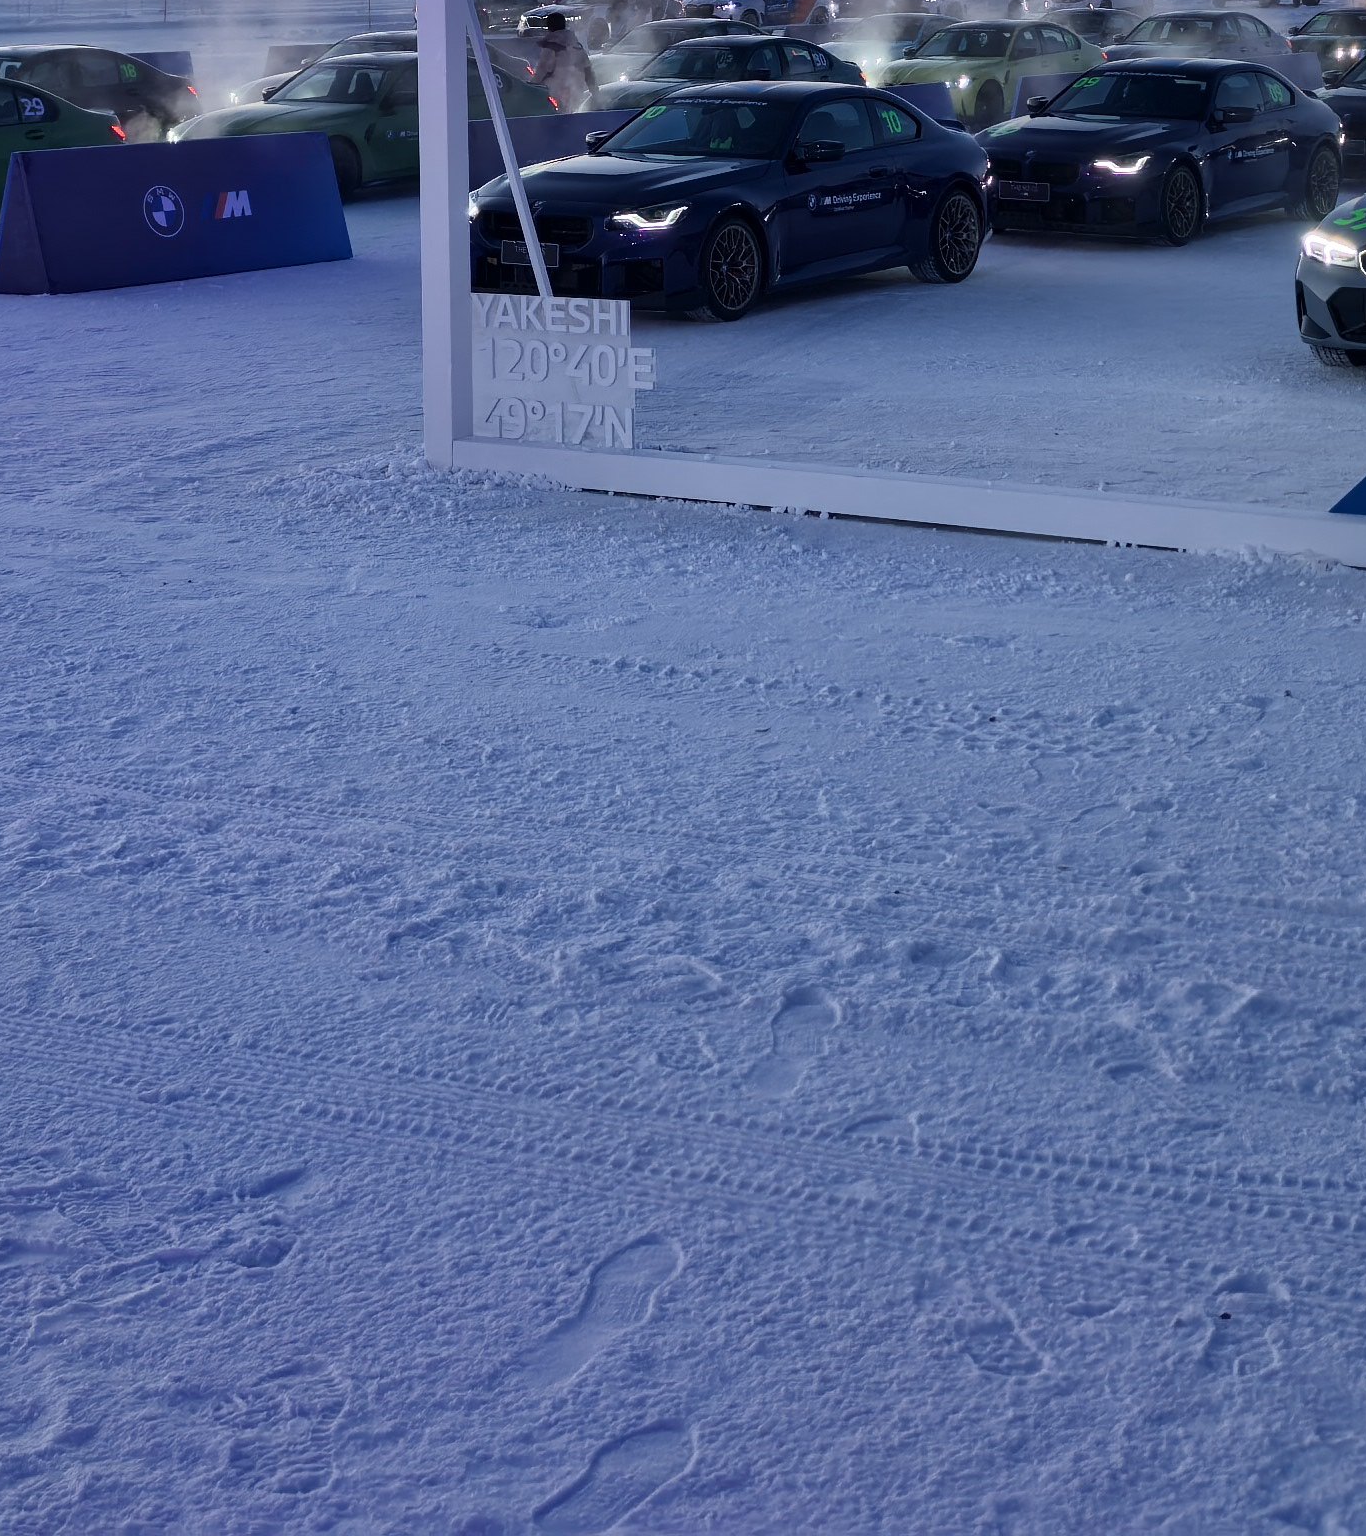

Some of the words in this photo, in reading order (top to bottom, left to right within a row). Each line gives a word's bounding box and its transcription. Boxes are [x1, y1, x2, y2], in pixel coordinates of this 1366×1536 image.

[1072, 76, 1100, 88] 09
[19, 96, 45, 116] 29
[881, 110, 902, 134] 10
[471, 293, 630, 336] YAKESHI
[478, 337, 656, 390] 120°40'E
[485, 397, 635, 449] 49°17'N
